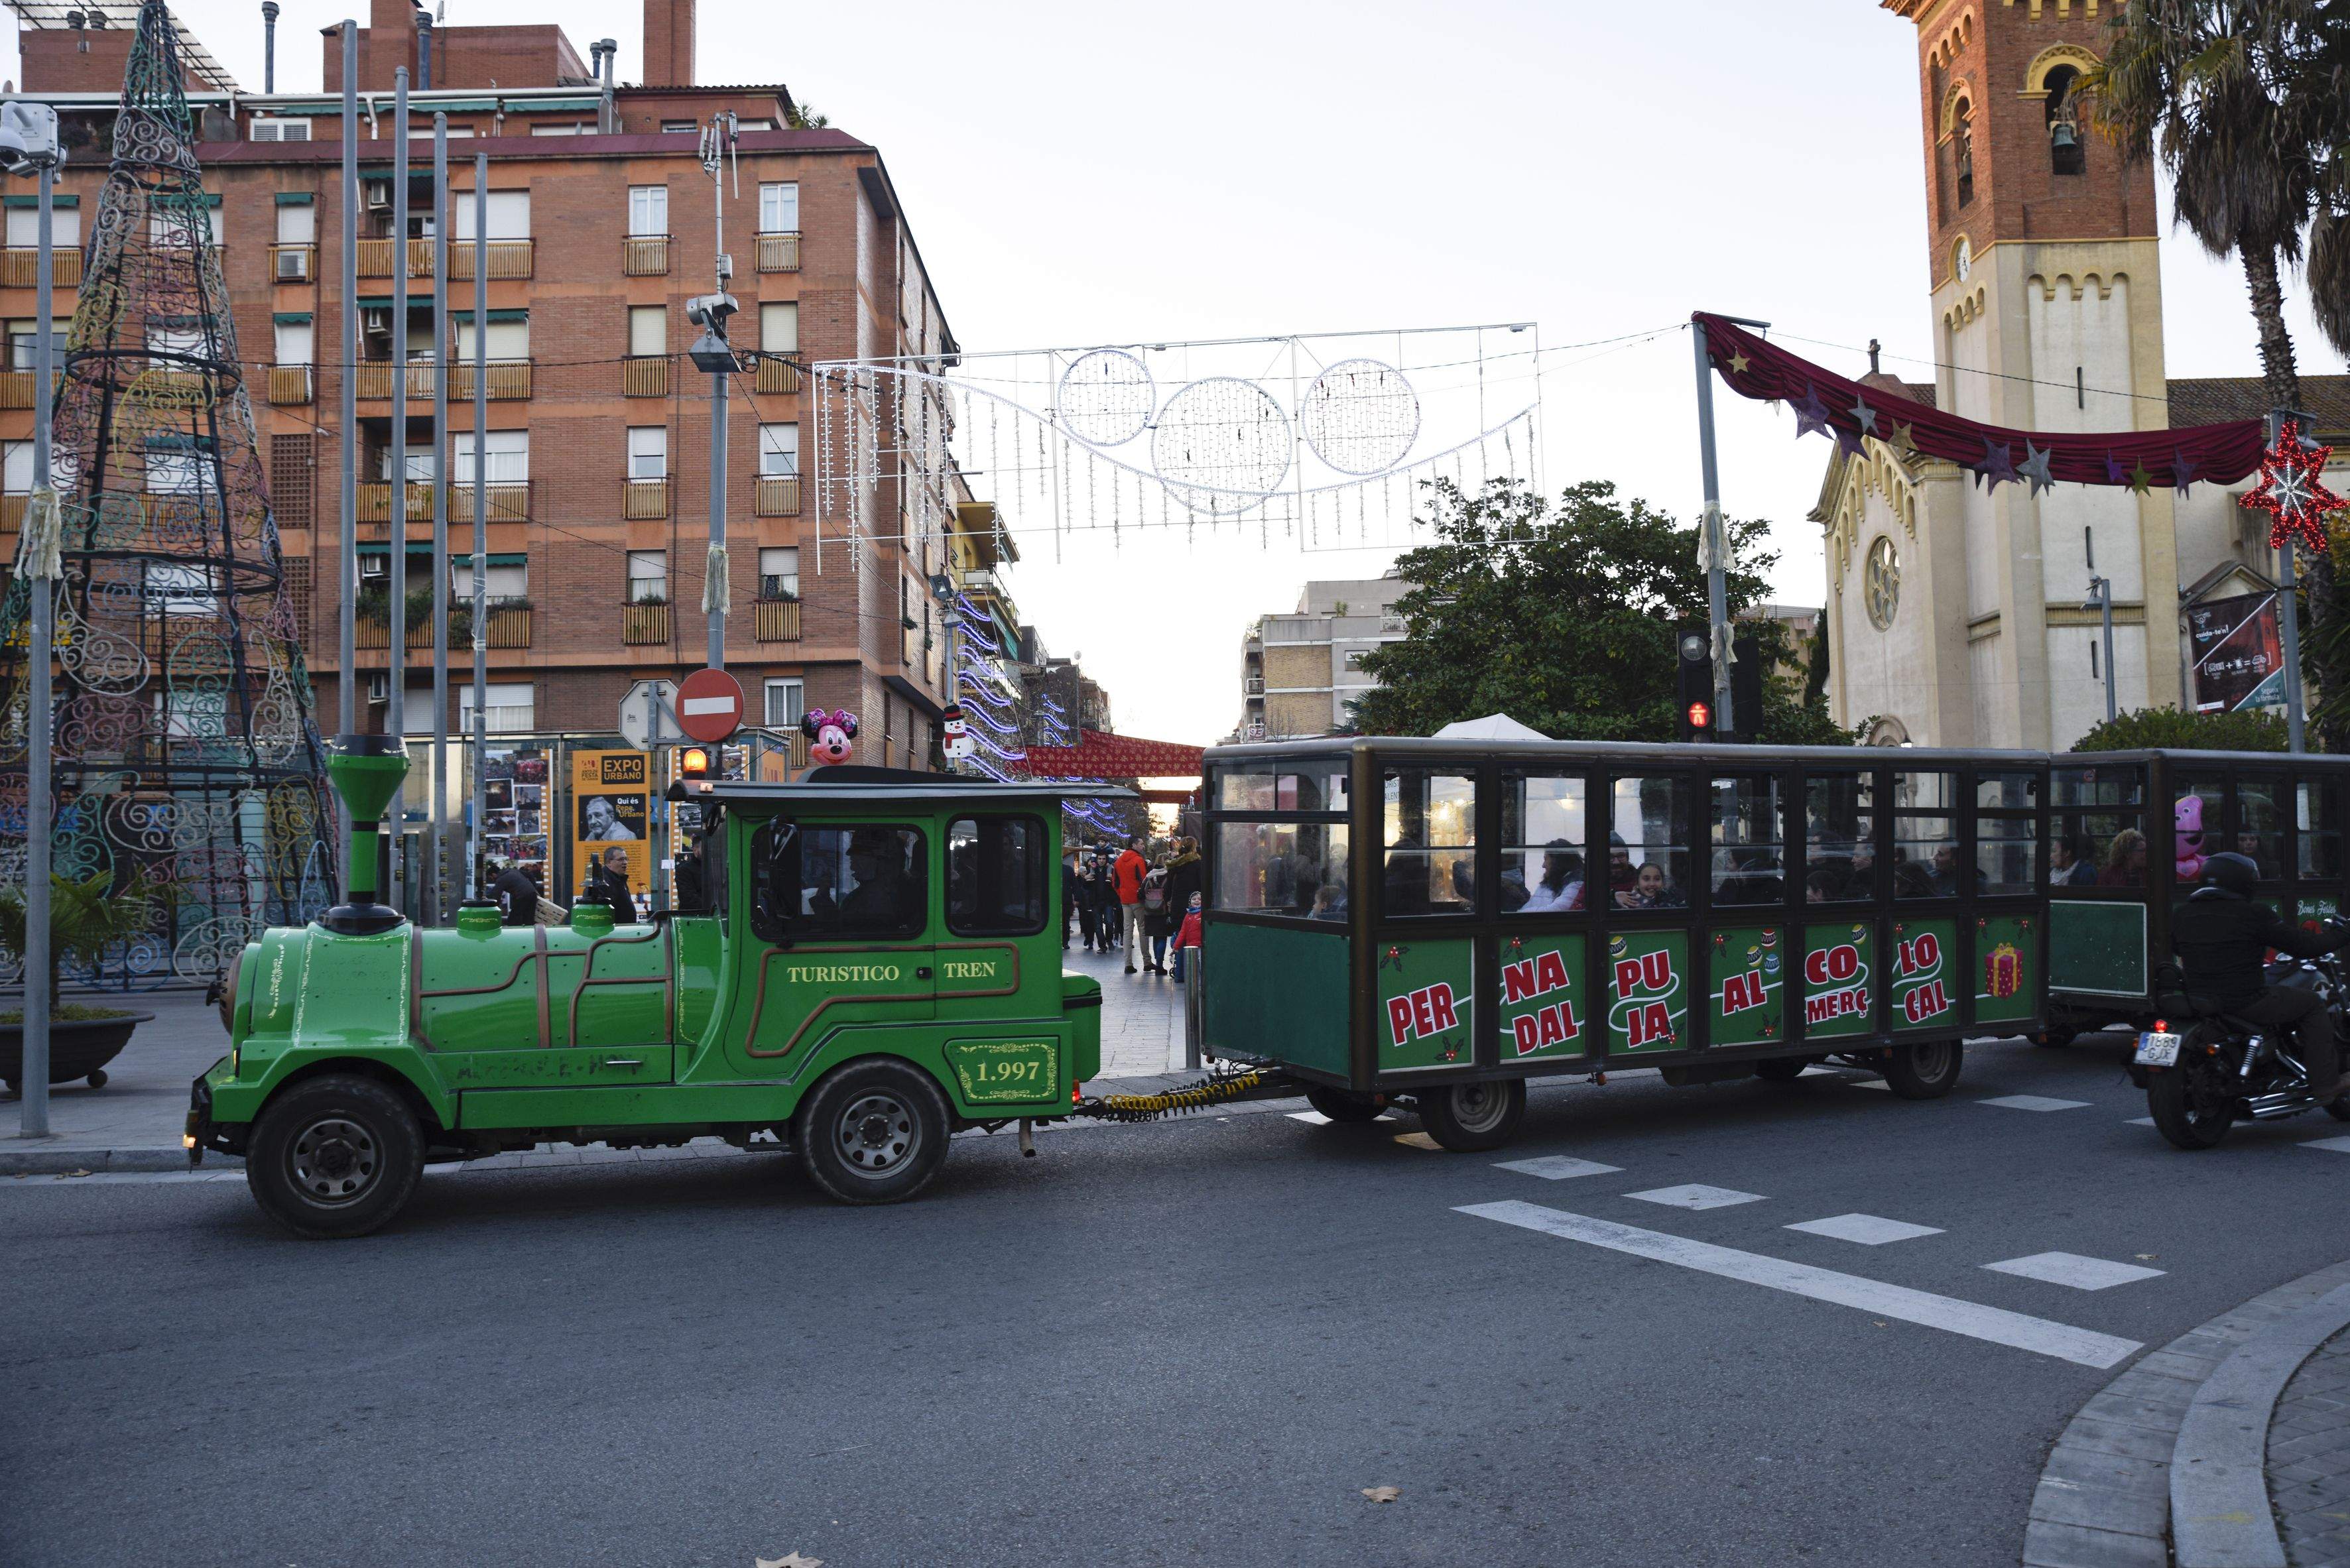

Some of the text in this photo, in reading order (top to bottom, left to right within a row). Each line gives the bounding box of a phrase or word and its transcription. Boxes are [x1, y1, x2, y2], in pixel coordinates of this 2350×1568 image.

[604, 759, 642, 772] EXPO
[787, 961, 997, 984] TURISTICO TREN
[1501, 949, 1571, 1005] NA
[1614, 949, 1672, 1000] PU
[1805, 943, 1859, 985] CO
[1897, 932, 1939, 977] LO
[1387, 982, 1459, 1047] PER
[1722, 969, 1767, 1016] AL
[1806, 988, 1868, 1024] MERÇ
[1904, 979, 1949, 1024] CAL
[1511, 1000, 1580, 1056] DAL
[1627, 1000, 1674, 1049] JA
[976, 1061, 1040, 1081] 1.997
